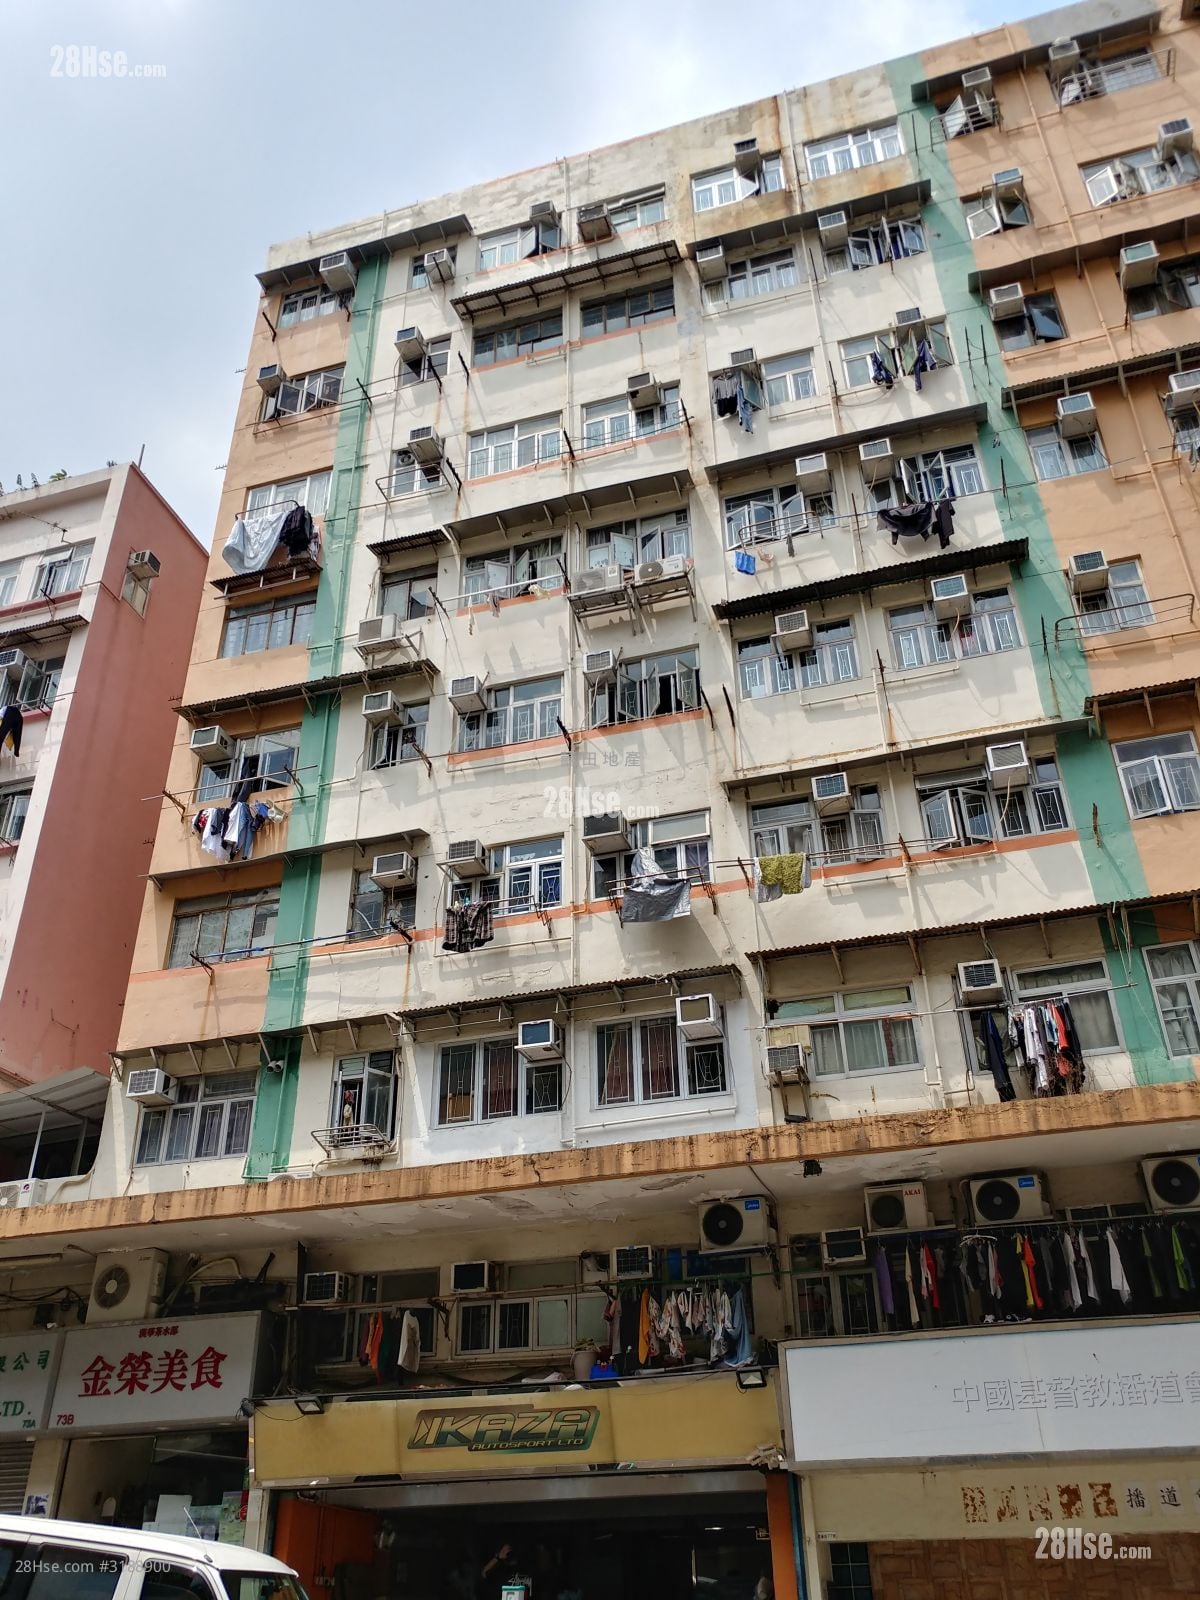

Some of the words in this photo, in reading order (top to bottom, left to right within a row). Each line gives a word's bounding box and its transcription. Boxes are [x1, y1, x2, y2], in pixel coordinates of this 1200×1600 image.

[78, 1346, 228, 1397] 金榮美食
[0, 1401, 31, 1417] TD.
[57, 1414, 75, 1426] 73B
[471, 1440, 553, 1450] AUTOSPORT
[557, 1438, 584, 1446] LTD
[1126, 1485, 1200, 1508] 播道
